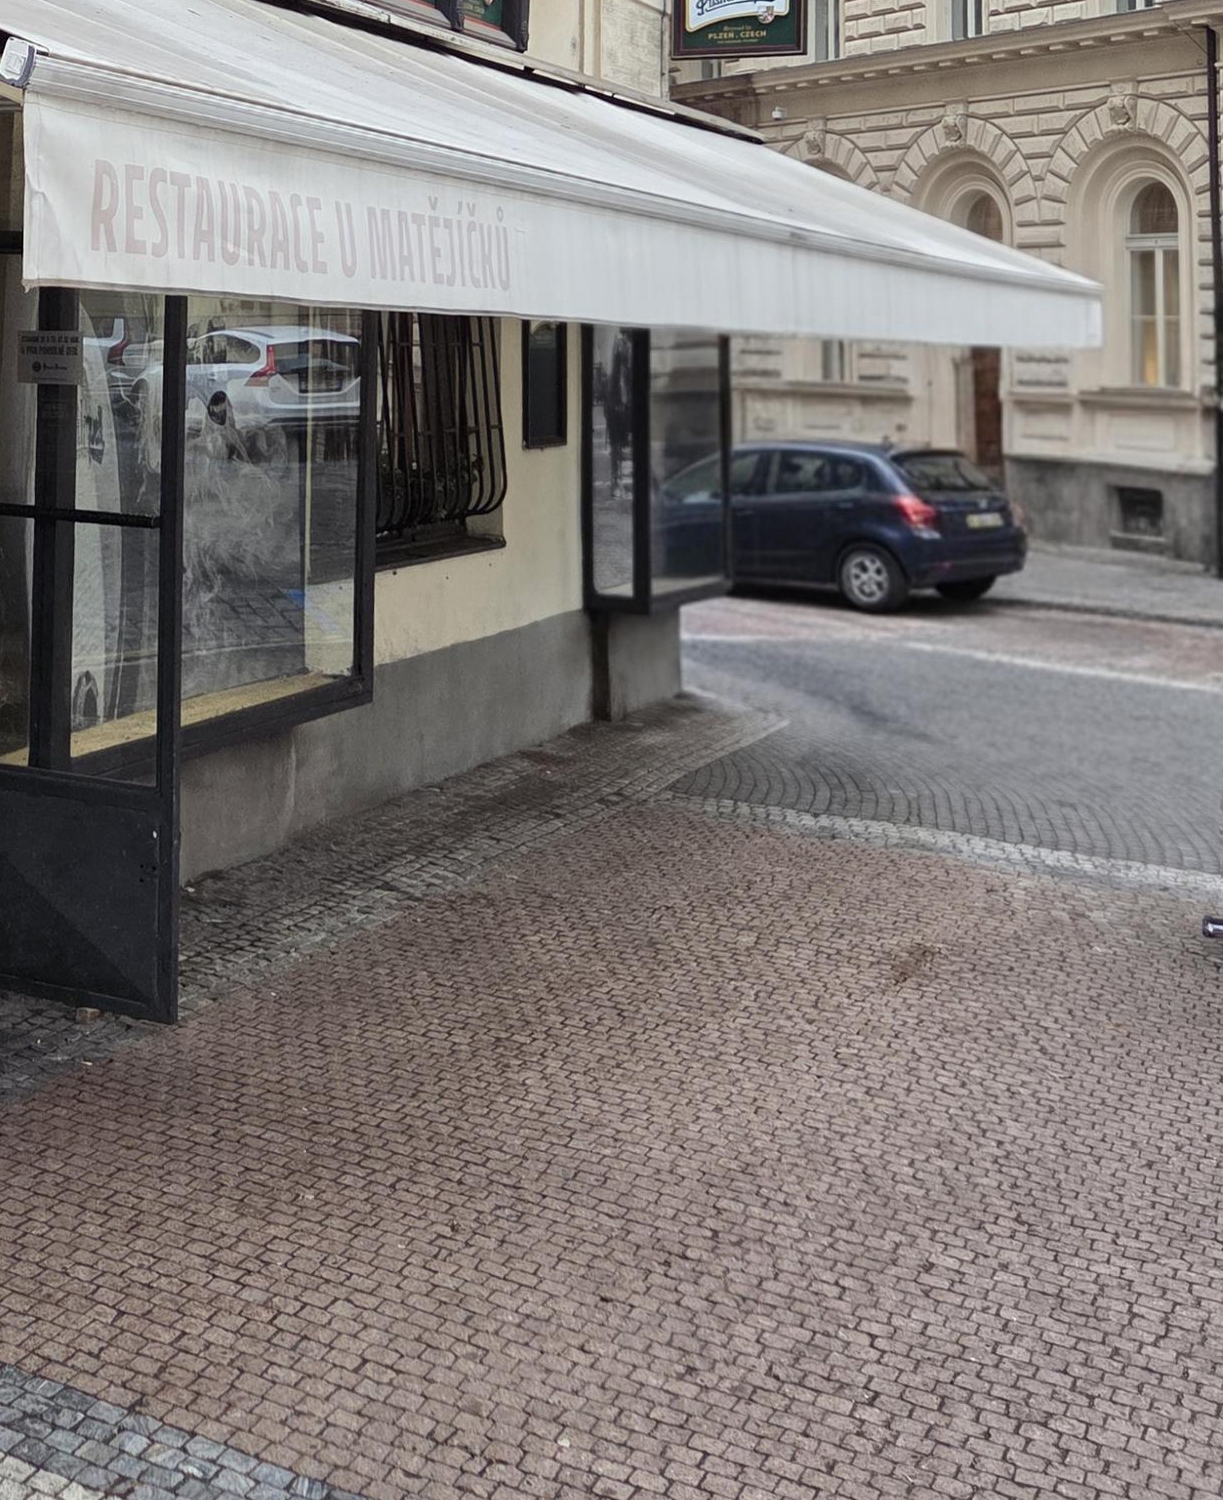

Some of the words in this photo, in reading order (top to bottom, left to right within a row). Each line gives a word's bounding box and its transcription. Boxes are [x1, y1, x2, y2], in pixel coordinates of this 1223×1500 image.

[740, 30, 767, 38] CZECH
[90, 158, 328, 274] RESTAURACE
[334, 200, 358, 278] U
[366, 195, 511, 291] MATĚJÍČKŮ
